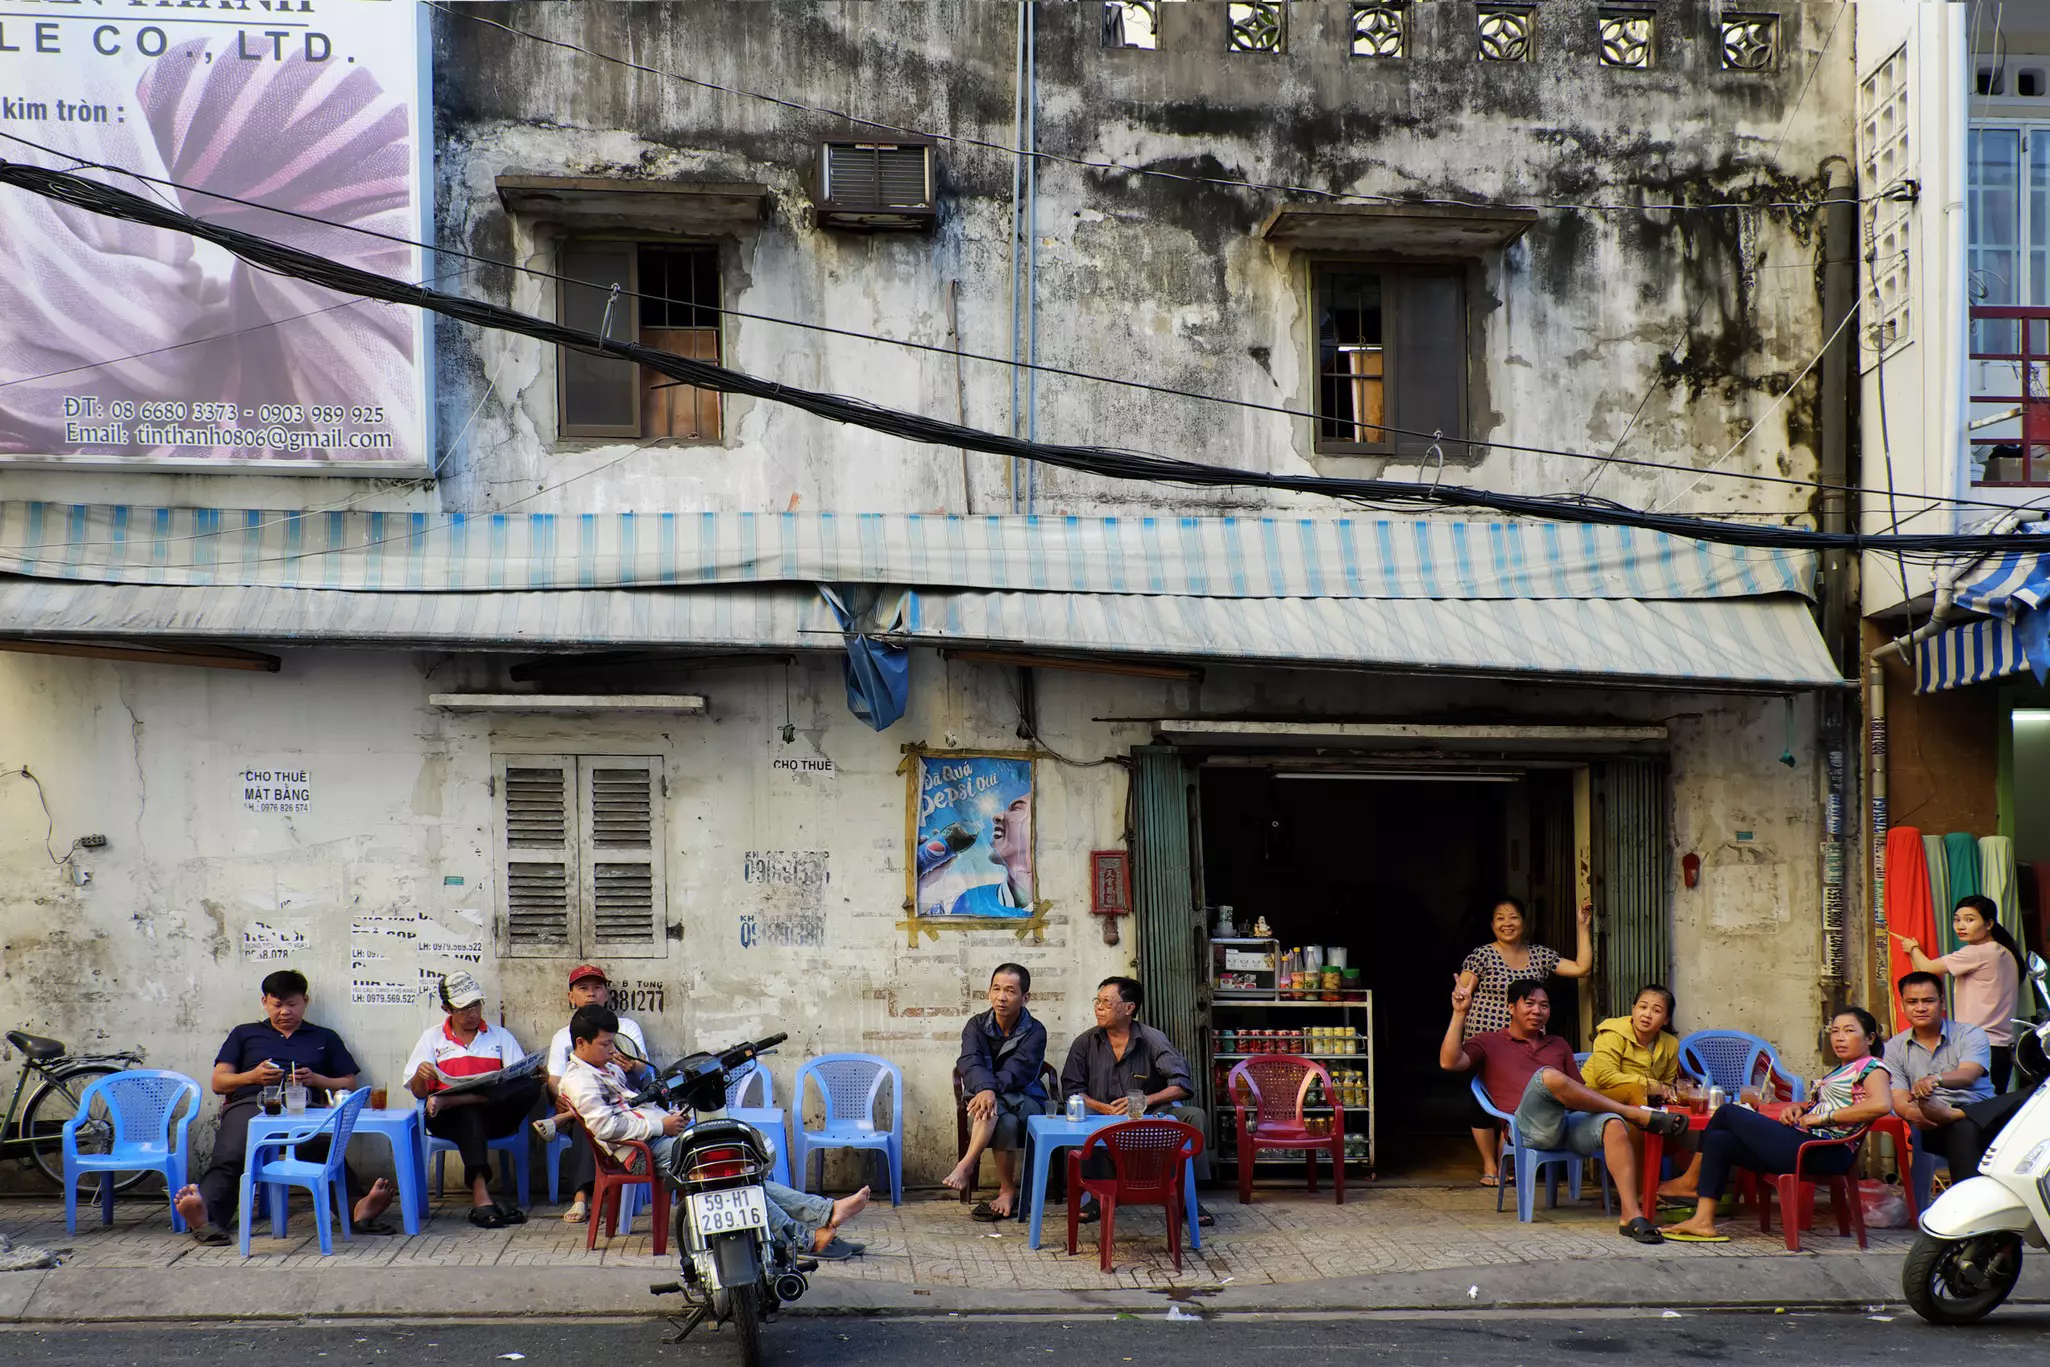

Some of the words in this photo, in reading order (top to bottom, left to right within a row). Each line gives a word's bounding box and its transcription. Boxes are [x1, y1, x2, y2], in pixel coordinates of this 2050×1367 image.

[237, 29, 355, 63] LTD.
[2, 96, 48, 121] kim
[57, 98, 108, 123] tròn
[64, 396, 104, 419] ĐT:
[111, 401, 135, 420] 08
[141, 401, 187, 422] 6680
[192, 402, 239, 423] 3373
[260, 404, 305, 424] 0903
[311, 405, 344, 425] 989
[351, 406, 385, 425] 925
[64, 421, 129, 445] Email:
[135, 422, 393, 451] tinthanh0806@gmail.com
[773, 759, 798, 770] CHO
[801, 758, 832, 771] THUÊ
[245, 771, 272, 782] CHO
[274, 769, 307, 782] THUÊ
[245, 785, 271, 803] MẶT
[274, 783, 310, 801] BẰNG
[261, 803, 278, 812] 0976
[280, 803, 293, 812] 826
[295, 803, 308, 812] 574
[352, 994, 365, 1003] LH:
[366, 994, 416, 1004] 0979.569.522
[705, 1190, 749, 1211] 59-H1
[702, 1208, 760, 1231] 289.16
